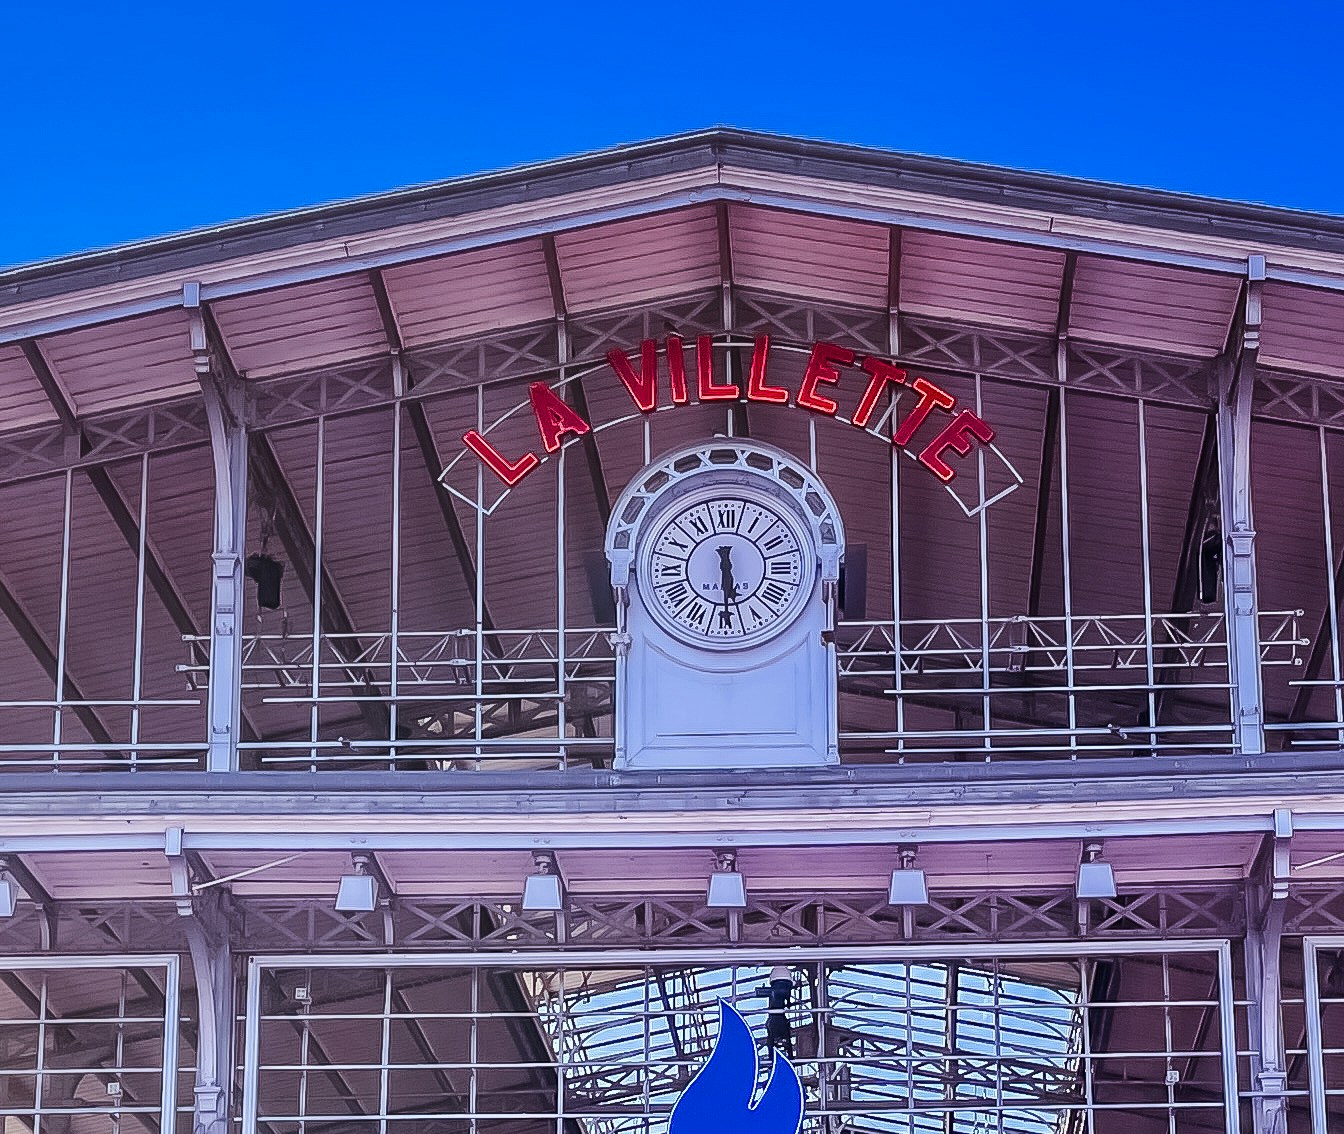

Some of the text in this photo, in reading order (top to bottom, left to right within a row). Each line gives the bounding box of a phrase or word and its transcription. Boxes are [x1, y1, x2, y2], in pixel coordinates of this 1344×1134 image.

[461, 334, 996, 487] LA VILLETTE
[689, 515, 709, 536] XI
[717, 510, 735, 528] XII
[668, 537, 688, 552] X
[764, 535, 784, 551] II
[771, 562, 791, 574] III
